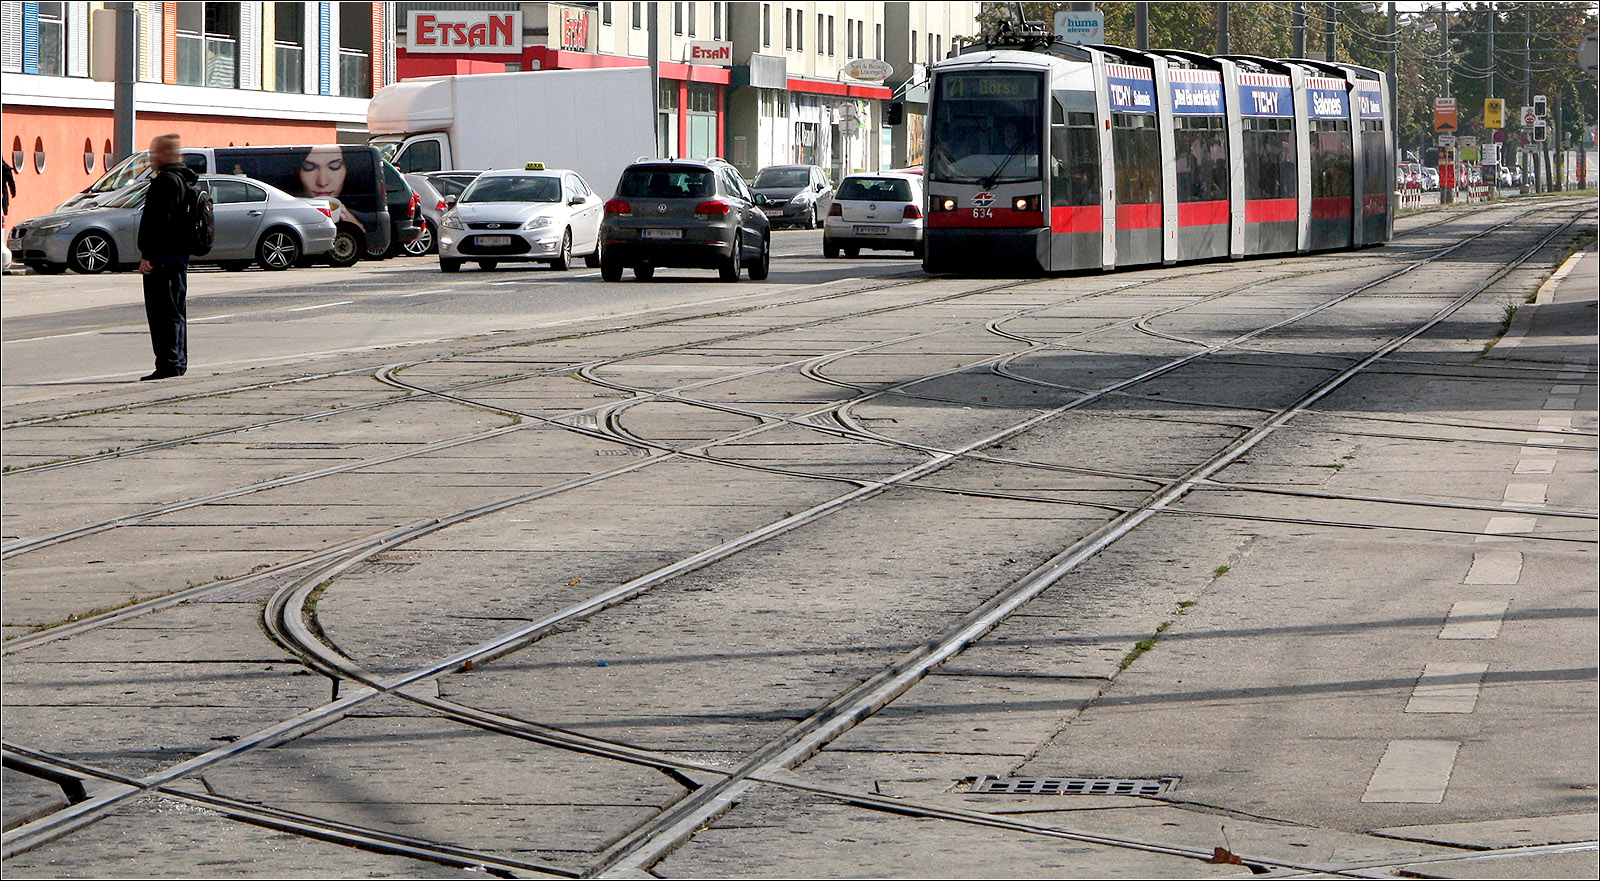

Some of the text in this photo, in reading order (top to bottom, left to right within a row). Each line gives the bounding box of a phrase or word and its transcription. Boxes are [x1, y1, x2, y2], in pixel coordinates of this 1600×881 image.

[1067, 18, 1098, 27] huma
[949, 78, 1020, 97] 71 Börse
[1110, 84, 1132, 106] TICHY
[1251, 90, 1279, 114] TICHY
[1313, 91, 1342, 115] Saloneis
[972, 208, 993, 218] 634
